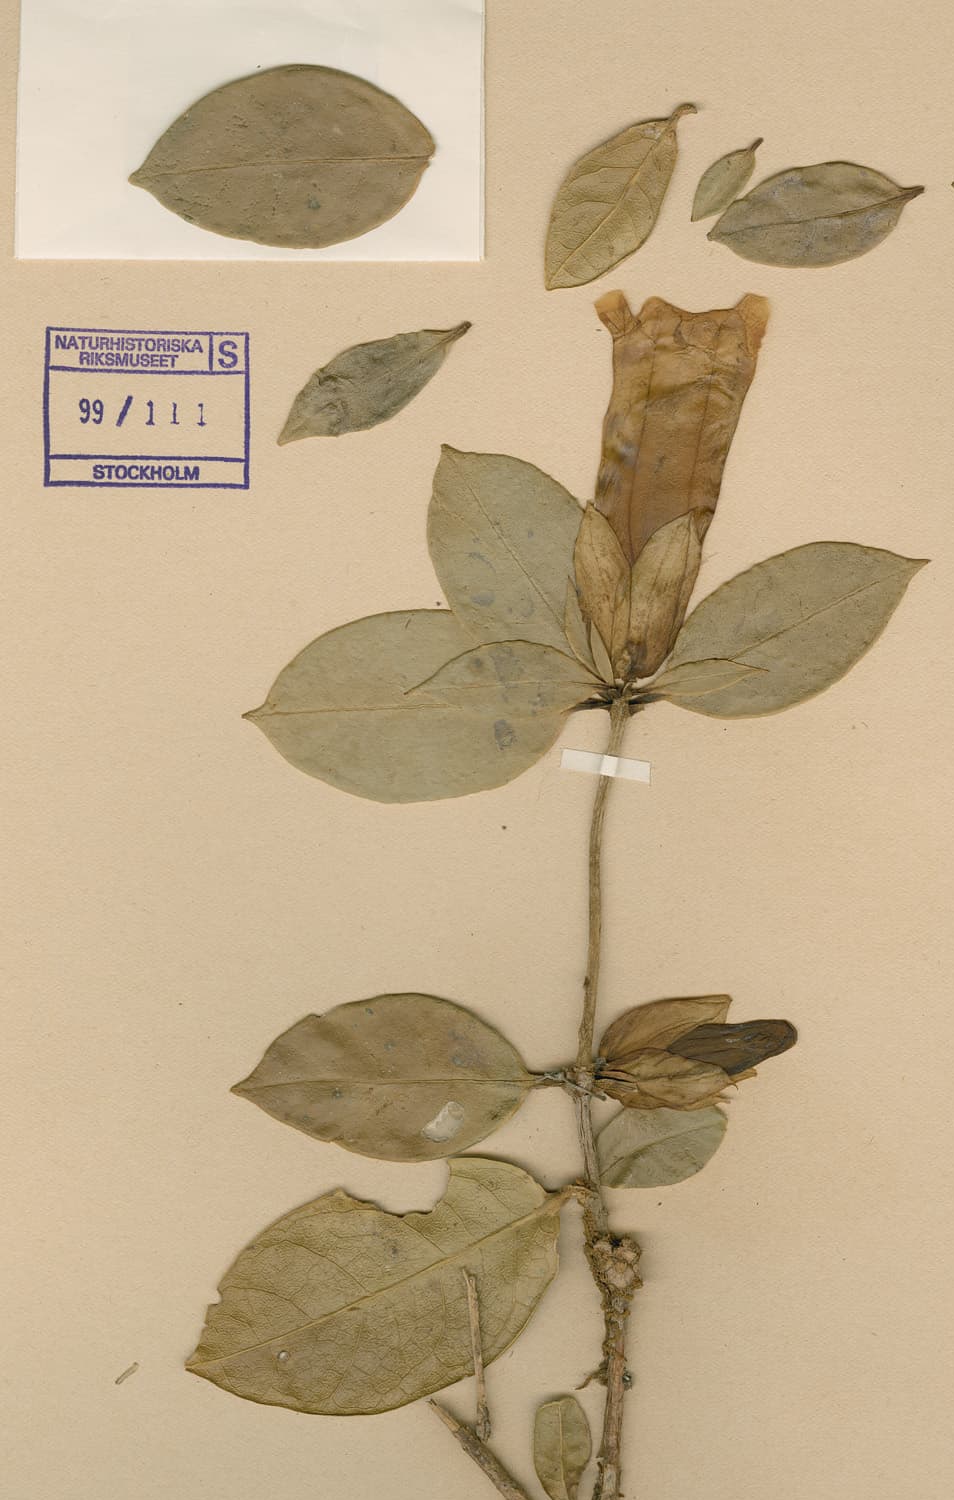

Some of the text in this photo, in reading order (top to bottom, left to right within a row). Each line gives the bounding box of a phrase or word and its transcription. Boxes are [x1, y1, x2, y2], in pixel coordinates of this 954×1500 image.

[55, 335, 203, 353] NATURHISTORISKA
[79, 352, 179, 368] RIKSMUSEET
[218, 340, 238, 368] S
[93, 465, 200, 480] STOCKHOLM
